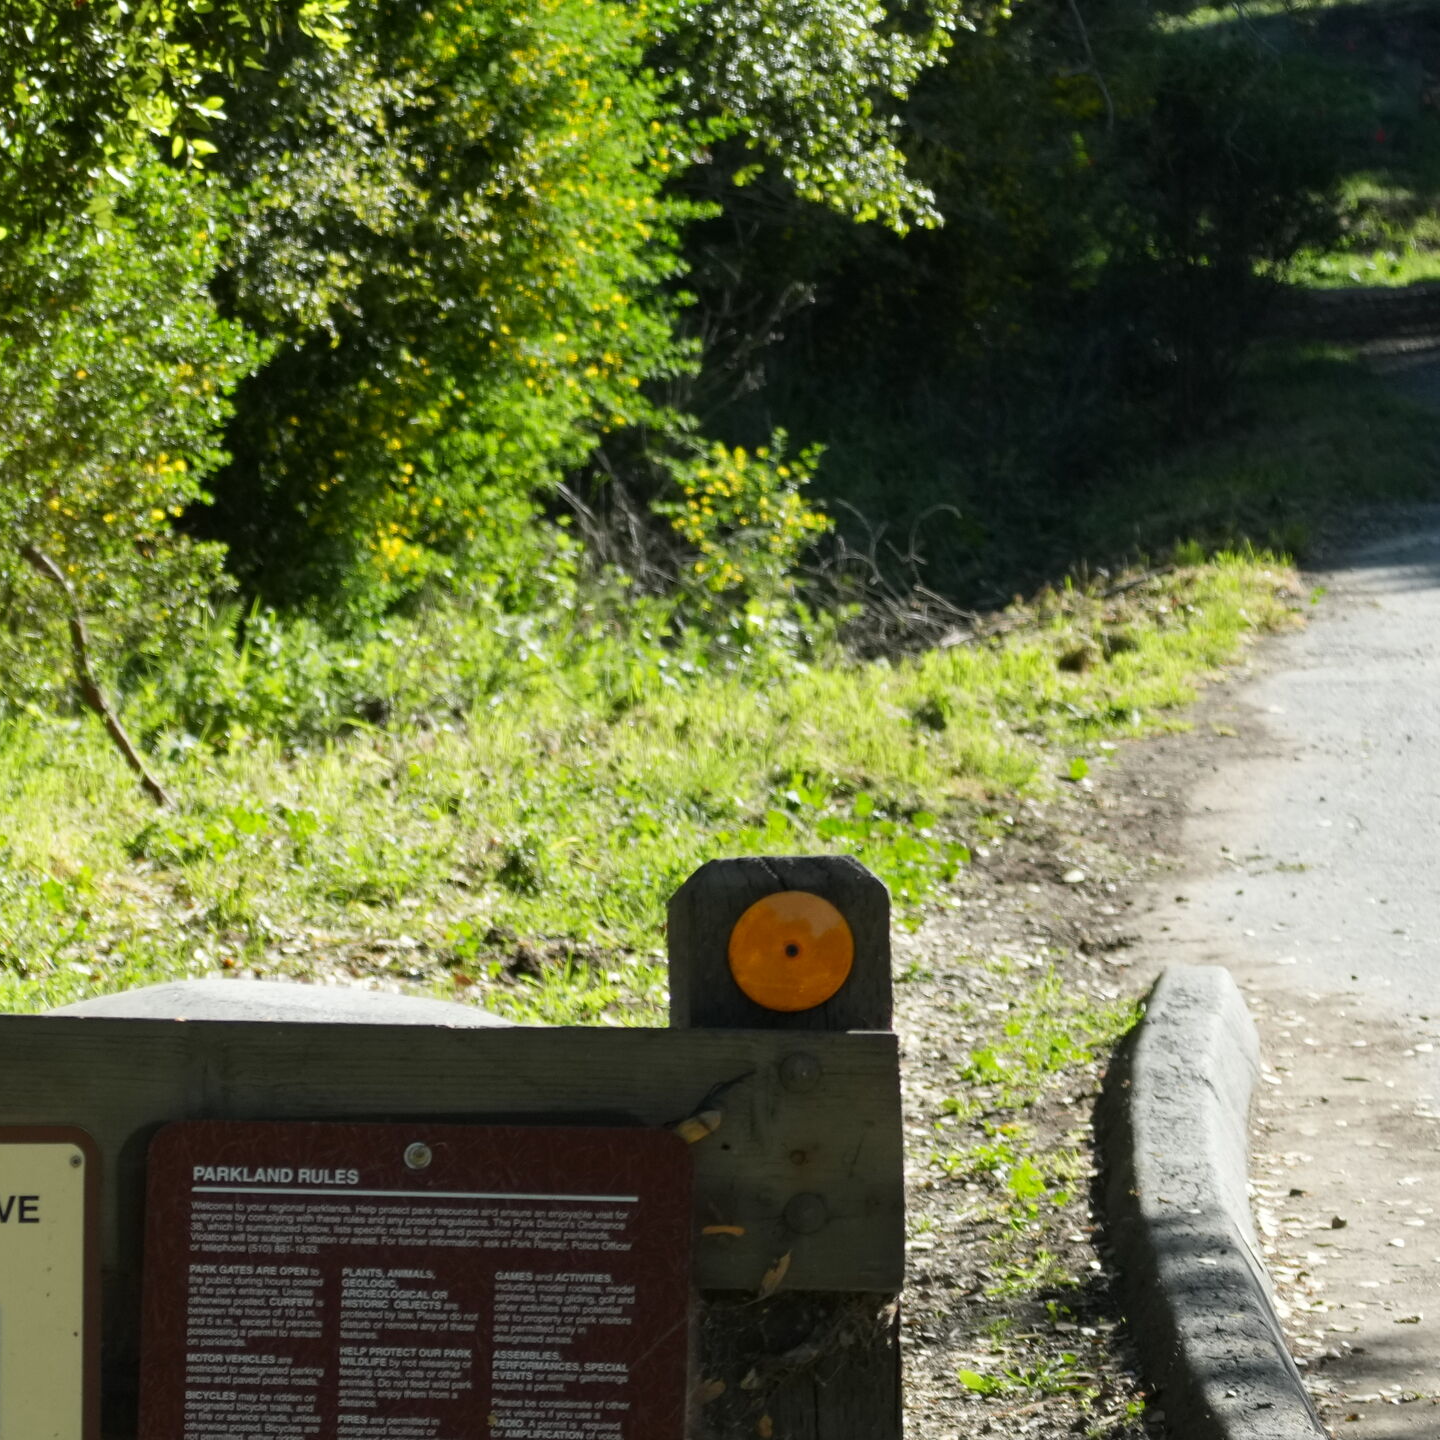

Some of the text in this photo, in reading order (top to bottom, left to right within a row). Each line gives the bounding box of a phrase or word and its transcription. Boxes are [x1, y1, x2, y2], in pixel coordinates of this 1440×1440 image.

[193, 1166, 359, 1184] PARKLAND RULES
[189, 1265, 217, 1274] PARK
[219, 1266, 254, 1275] GATES
[256, 1266, 278, 1275] ARE
[280, 1267, 309, 1276] OPEN
[496, 1272, 533, 1281] GAMES
[342, 1289, 448, 1300] ARCHEOLOGICAL OR
[341, 1299, 390, 1309] HISTORIC
[394, 1300, 442, 1310] OBJECTS
[340, 1346, 472, 1358] HELP PROTECT OUR PARK
[187, 1354, 224, 1363] MOTOR
[225, 1354, 276, 1364] VEHICLES
[340, 1357, 387, 1367] WILDLIFE
[584, 1363, 627, 1372] SPECIAL
[492, 1371, 534, 1380] EVENTS
[186, 1391, 237, 1401] BICYCLES
[338, 1415, 368, 1424] FIRES
